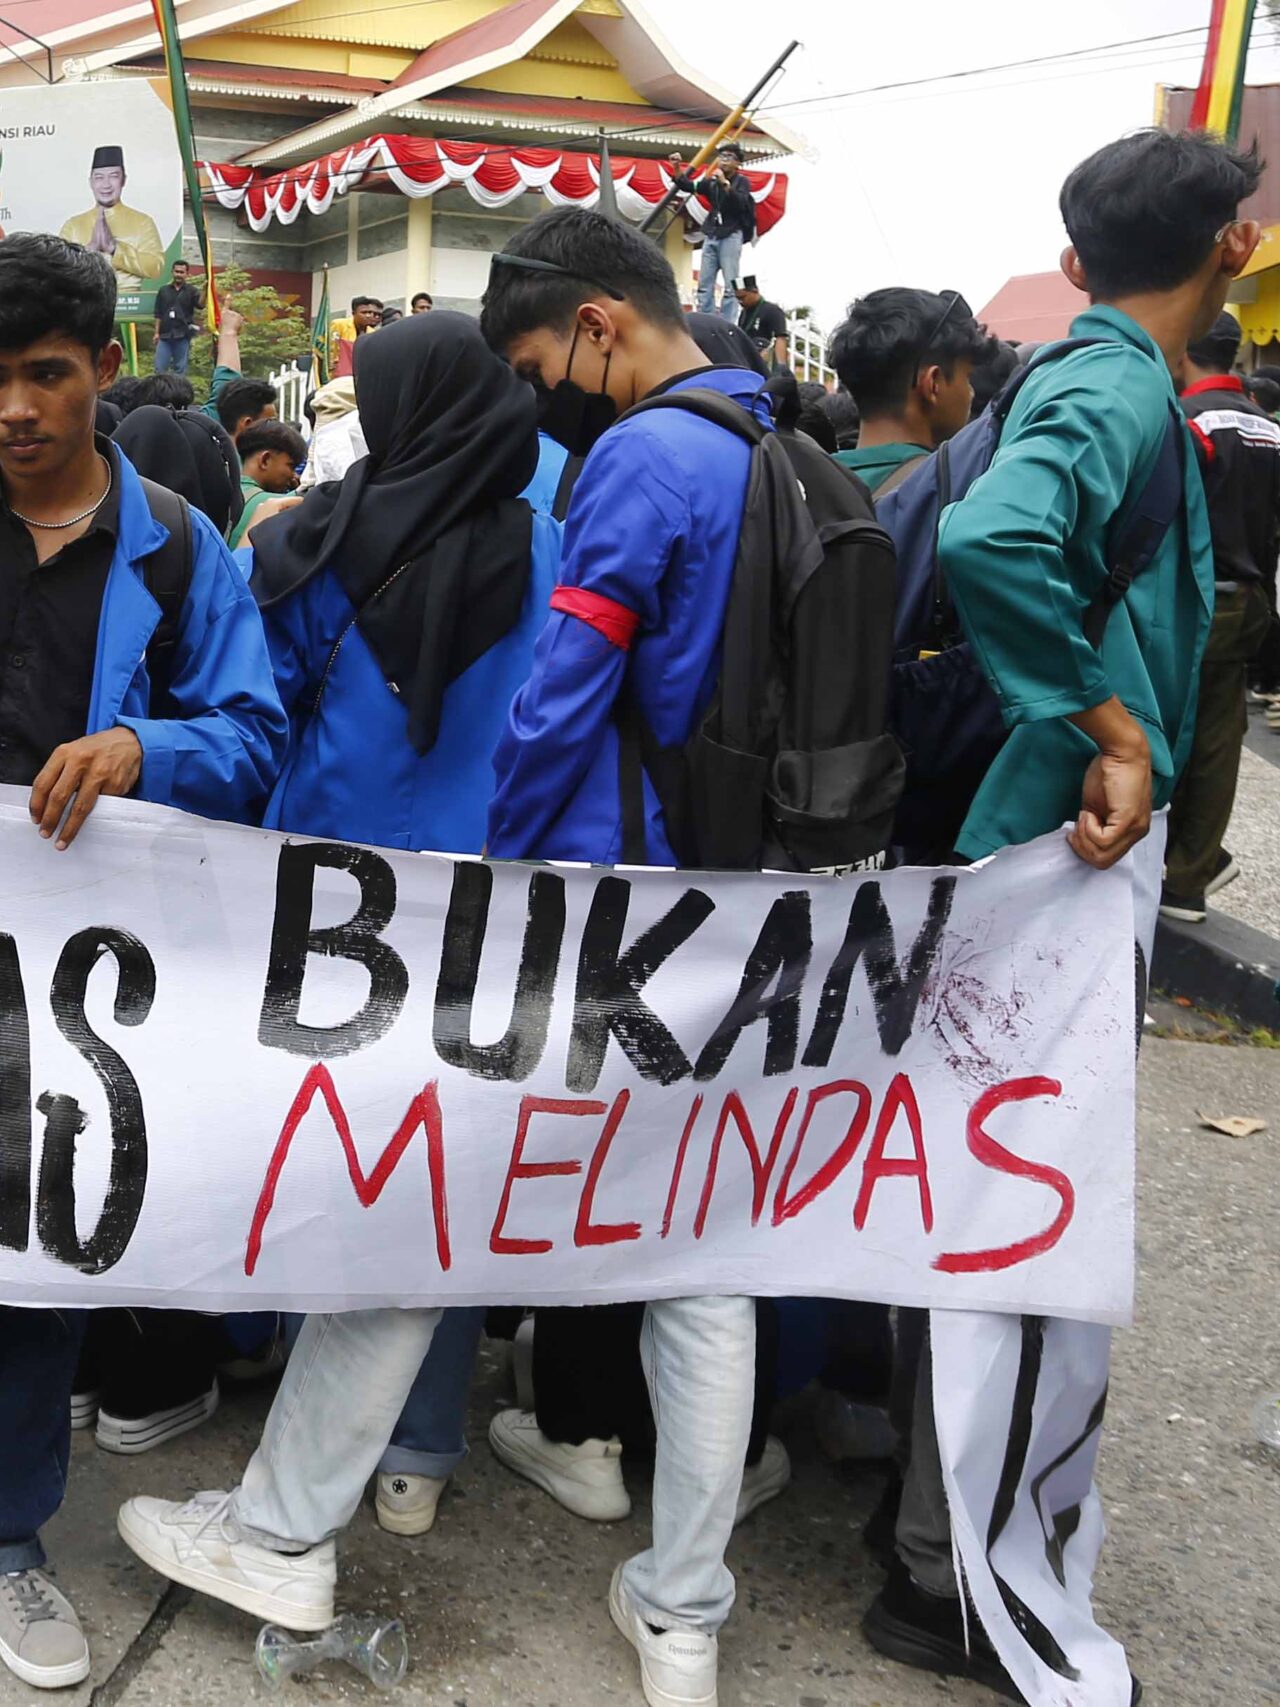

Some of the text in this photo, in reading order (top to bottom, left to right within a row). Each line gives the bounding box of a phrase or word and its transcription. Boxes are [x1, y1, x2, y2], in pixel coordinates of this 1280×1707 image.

[23, 124, 56, 137] RIAU
[257, 841, 958, 1093] BUKAN
[243, 1061, 1076, 1277] MELINDAS
